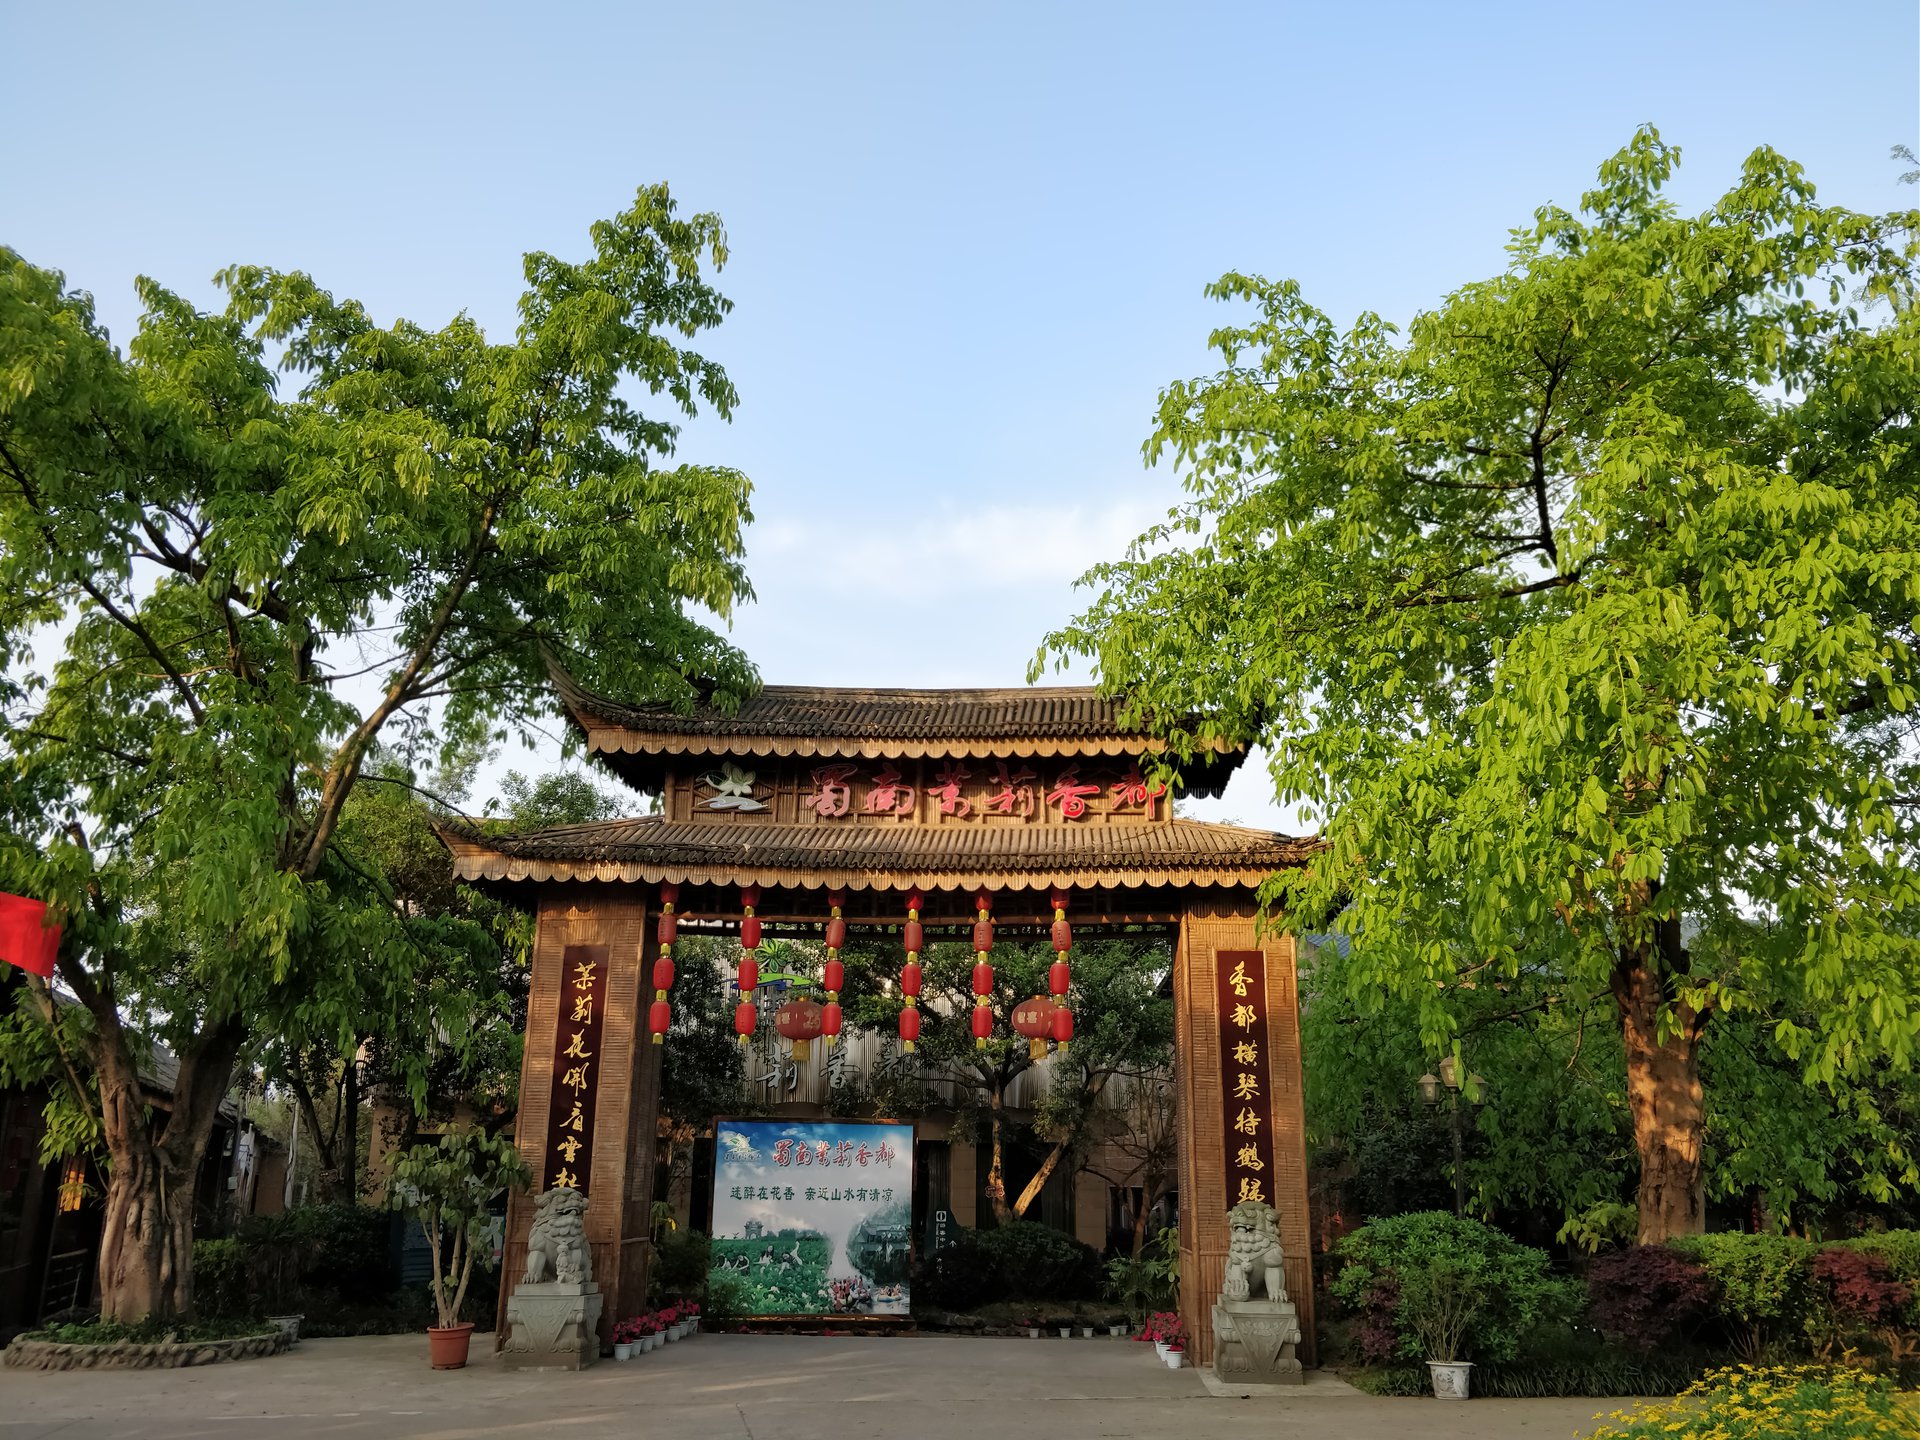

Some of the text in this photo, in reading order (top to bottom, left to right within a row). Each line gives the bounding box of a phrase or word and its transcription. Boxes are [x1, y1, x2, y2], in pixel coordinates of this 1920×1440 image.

[806, 761, 1168, 819] 蜀南茉莉香都
[773, 1139, 896, 1168] 蜀南茉莉香都
[804, 1187, 894, 1202] 亲近山水有清凉
